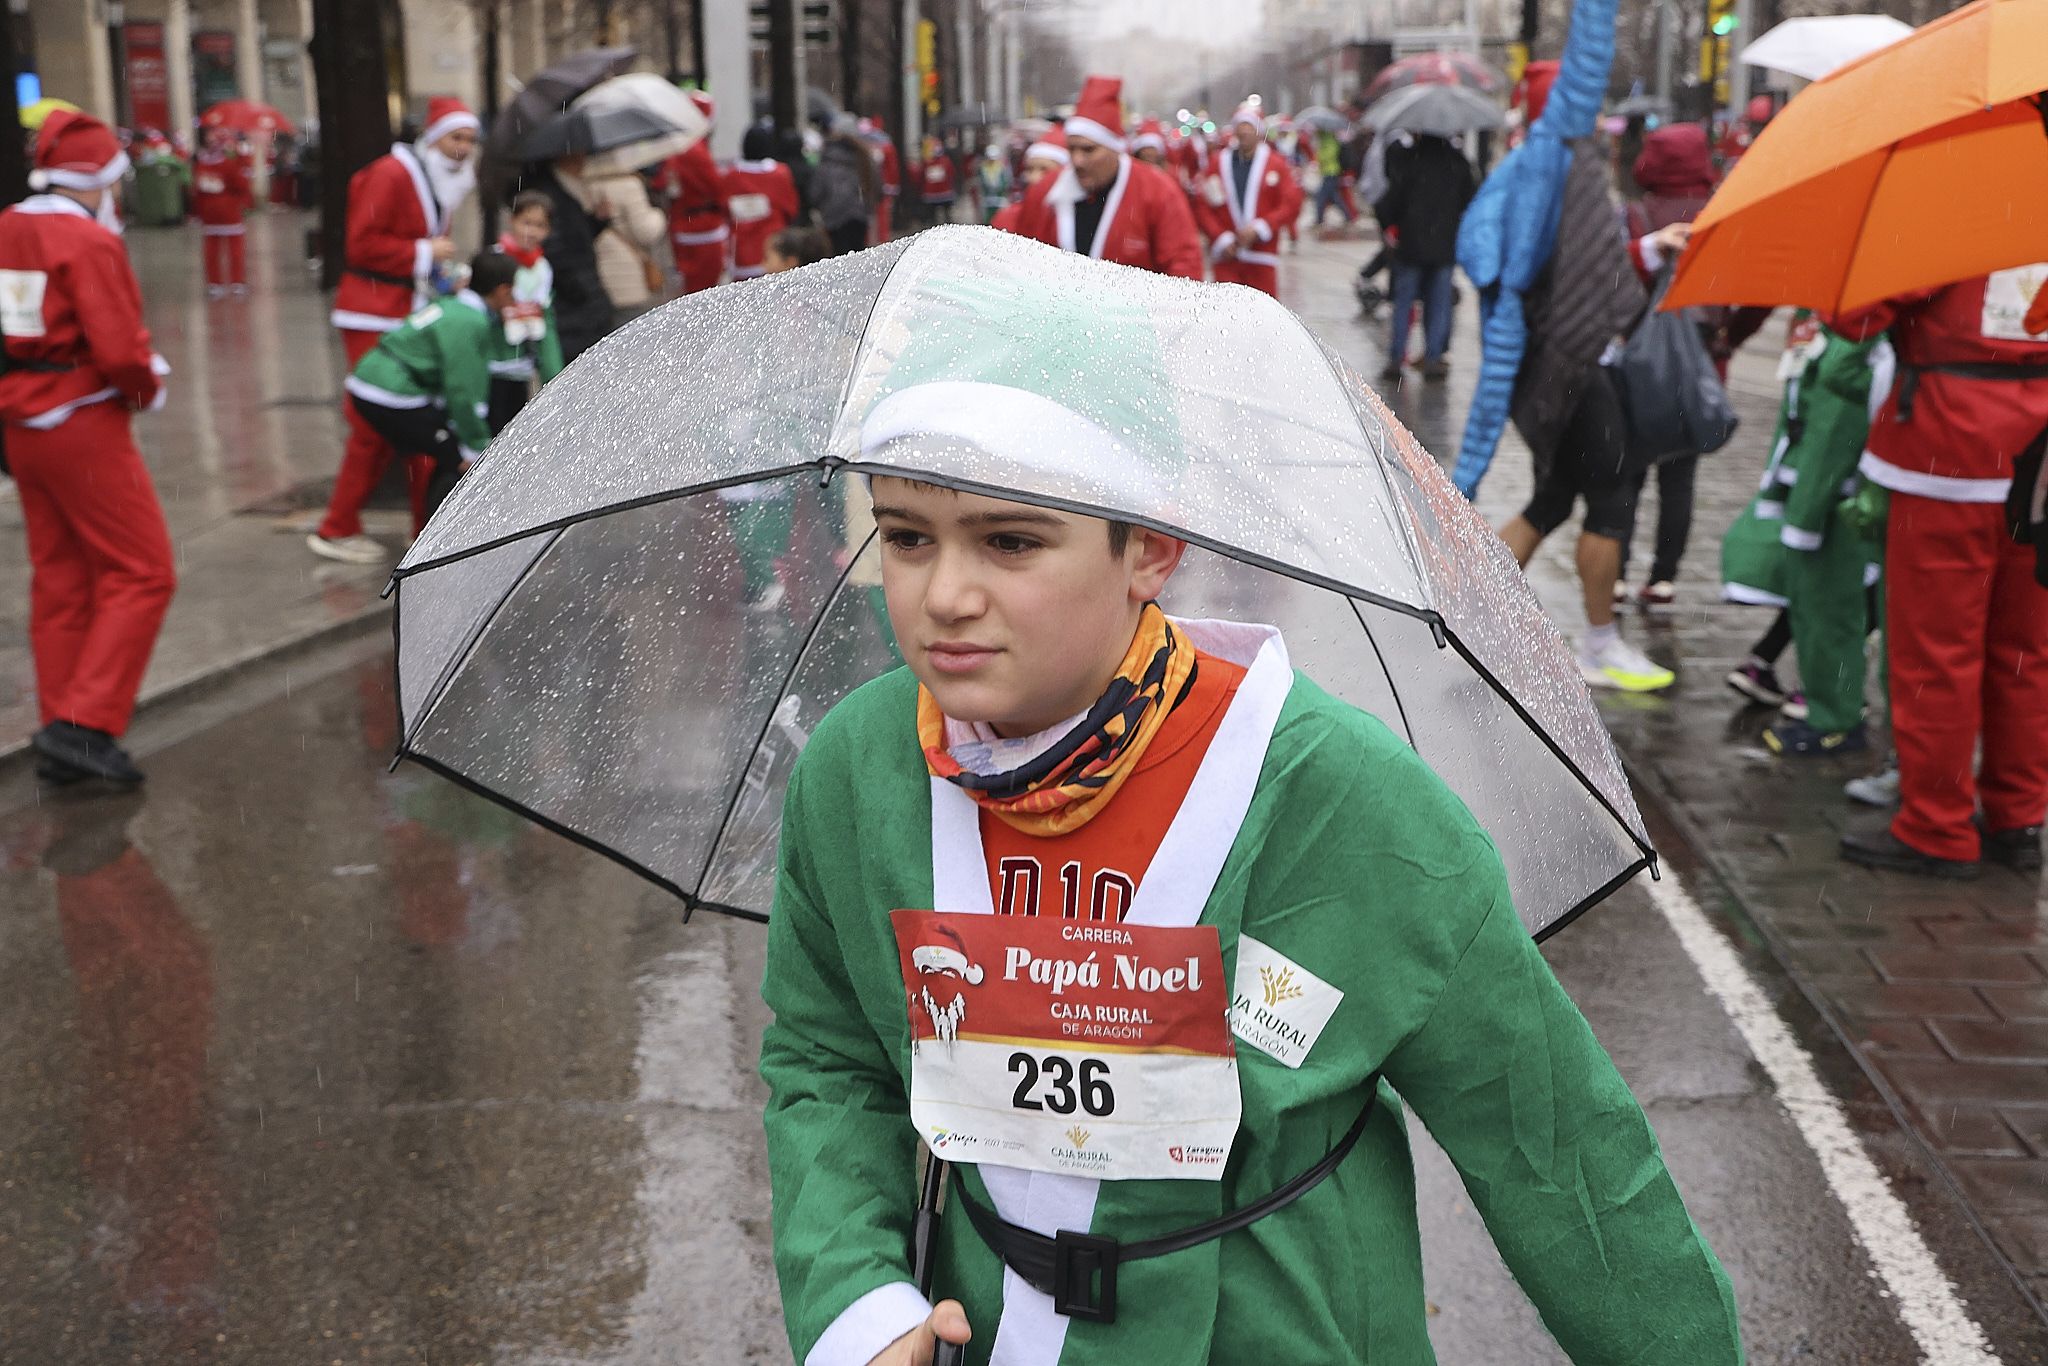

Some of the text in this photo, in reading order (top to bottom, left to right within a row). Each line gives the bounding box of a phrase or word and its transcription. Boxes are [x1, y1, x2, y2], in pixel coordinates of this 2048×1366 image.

[1062, 925, 1133, 945] CARRERA
[1002, 946, 1203, 995] Papá Noel
[1050, 1002, 1153, 1024] CAJA RURAL
[1233, 993, 1308, 1050] JA RURAL
[1062, 1022, 1143, 1040] DE ARAGÓN
[1007, 1051, 1116, 1117] 236
[1050, 1146, 1113, 1162] CAJA RURAL
